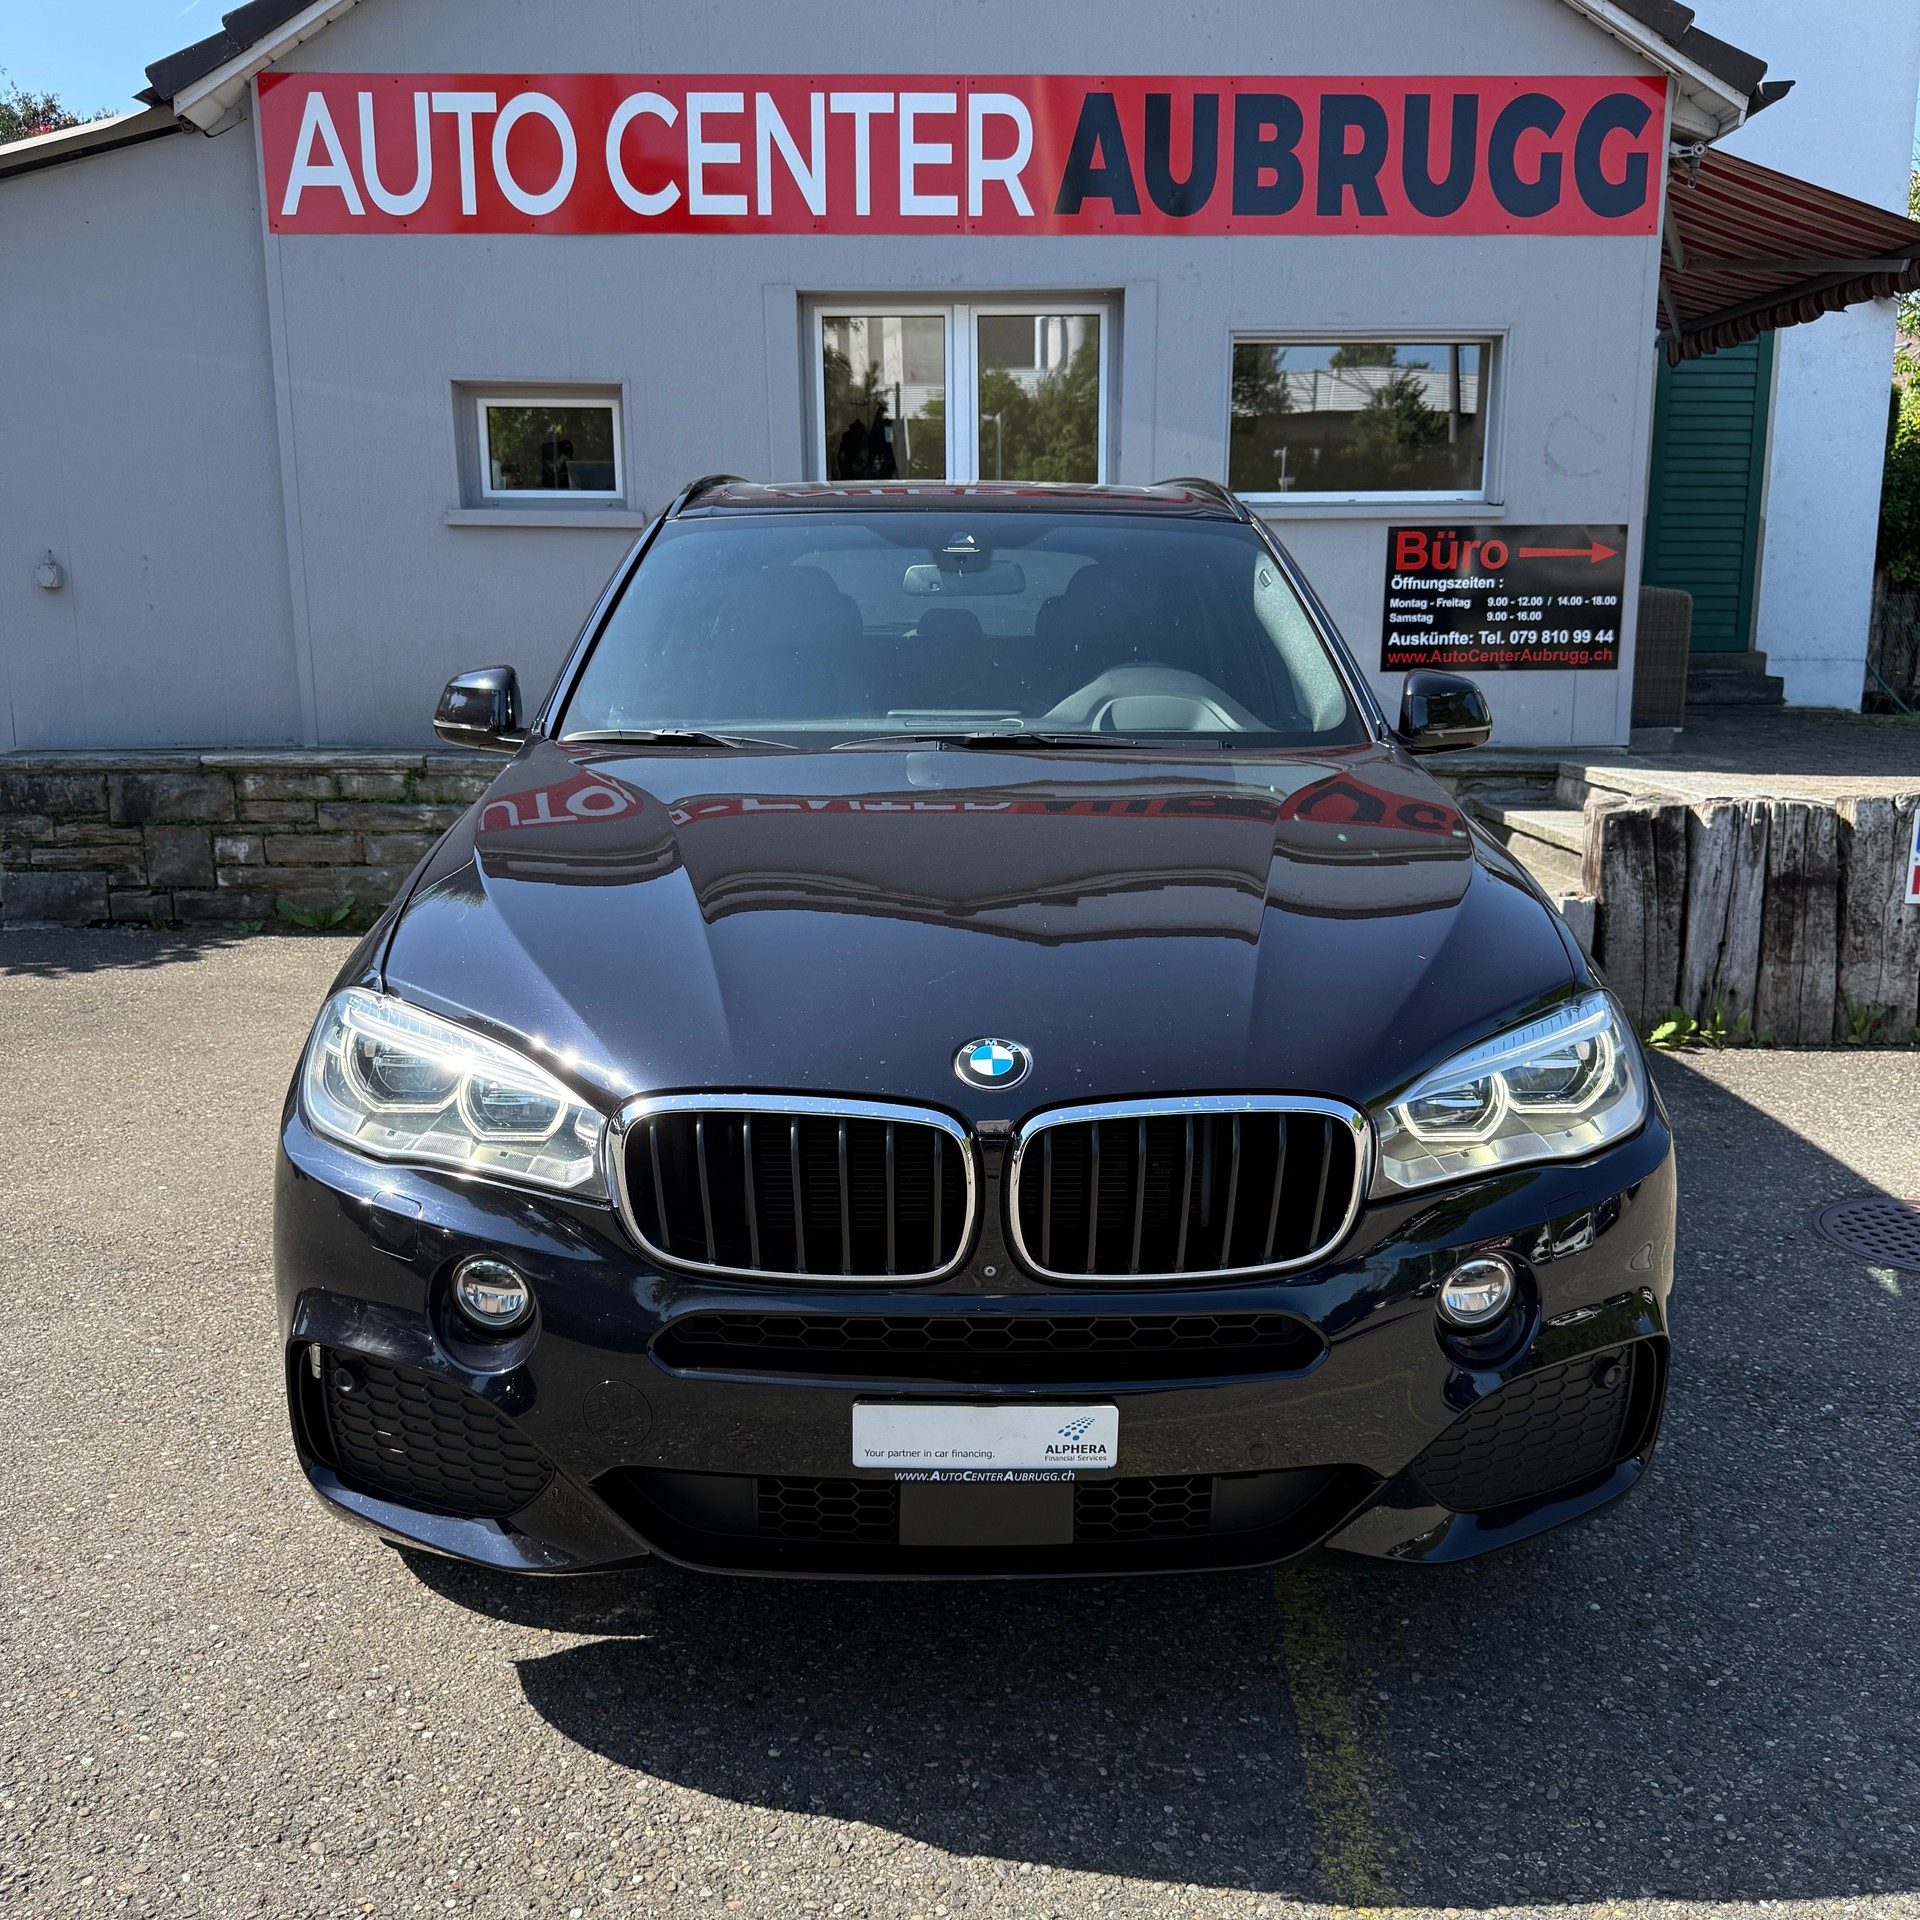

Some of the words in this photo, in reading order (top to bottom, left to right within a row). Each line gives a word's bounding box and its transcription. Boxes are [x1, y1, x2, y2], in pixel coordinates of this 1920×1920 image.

[281, 91, 578, 216] AUTO
[605, 91, 1035, 218] CENTER
[1053, 92, 1653, 219] AUBRUGG
[1395, 530, 1509, 571] Büro
[1391, 574, 1495, 592] Öffnungszeiten
[1389, 598, 1428, 610] Montag
[1436, 598, 1472, 610] Freitag
[1487, 596, 1508, 607] 9.00
[1517, 596, 1543, 607] 12.00
[1557, 595, 1583, 606] 14.00
[1591, 595, 1617, 606] 18.00
[1389, 612, 1434, 625] Samstag
[1486, 611, 1508, 622] 9.00
[1516, 611, 1543, 622] 16.00
[1388, 630, 1474, 646] Auskünfte:
[1478, 630, 1505, 645] Tel.
[1509, 630, 1538, 645] 079
[1541, 629, 1568, 644] 810
[1572, 629, 1592, 644] 99
[1594, 629, 1614, 644] 44
[1388, 647, 1612, 665] www.AutoCenterAubrugg.ch
[963, 1039, 1021, 1054] BMW
[864, 1448, 885, 1458] Your
[887, 1449, 921, 1459] partner
[923, 1449, 932, 1458] in
[934, 1450, 949, 1458] car
[951, 1449, 996, 1460] financing.
[1045, 1444, 1107, 1454] ALPHERA
[1077, 1454, 1107, 1462] Services
